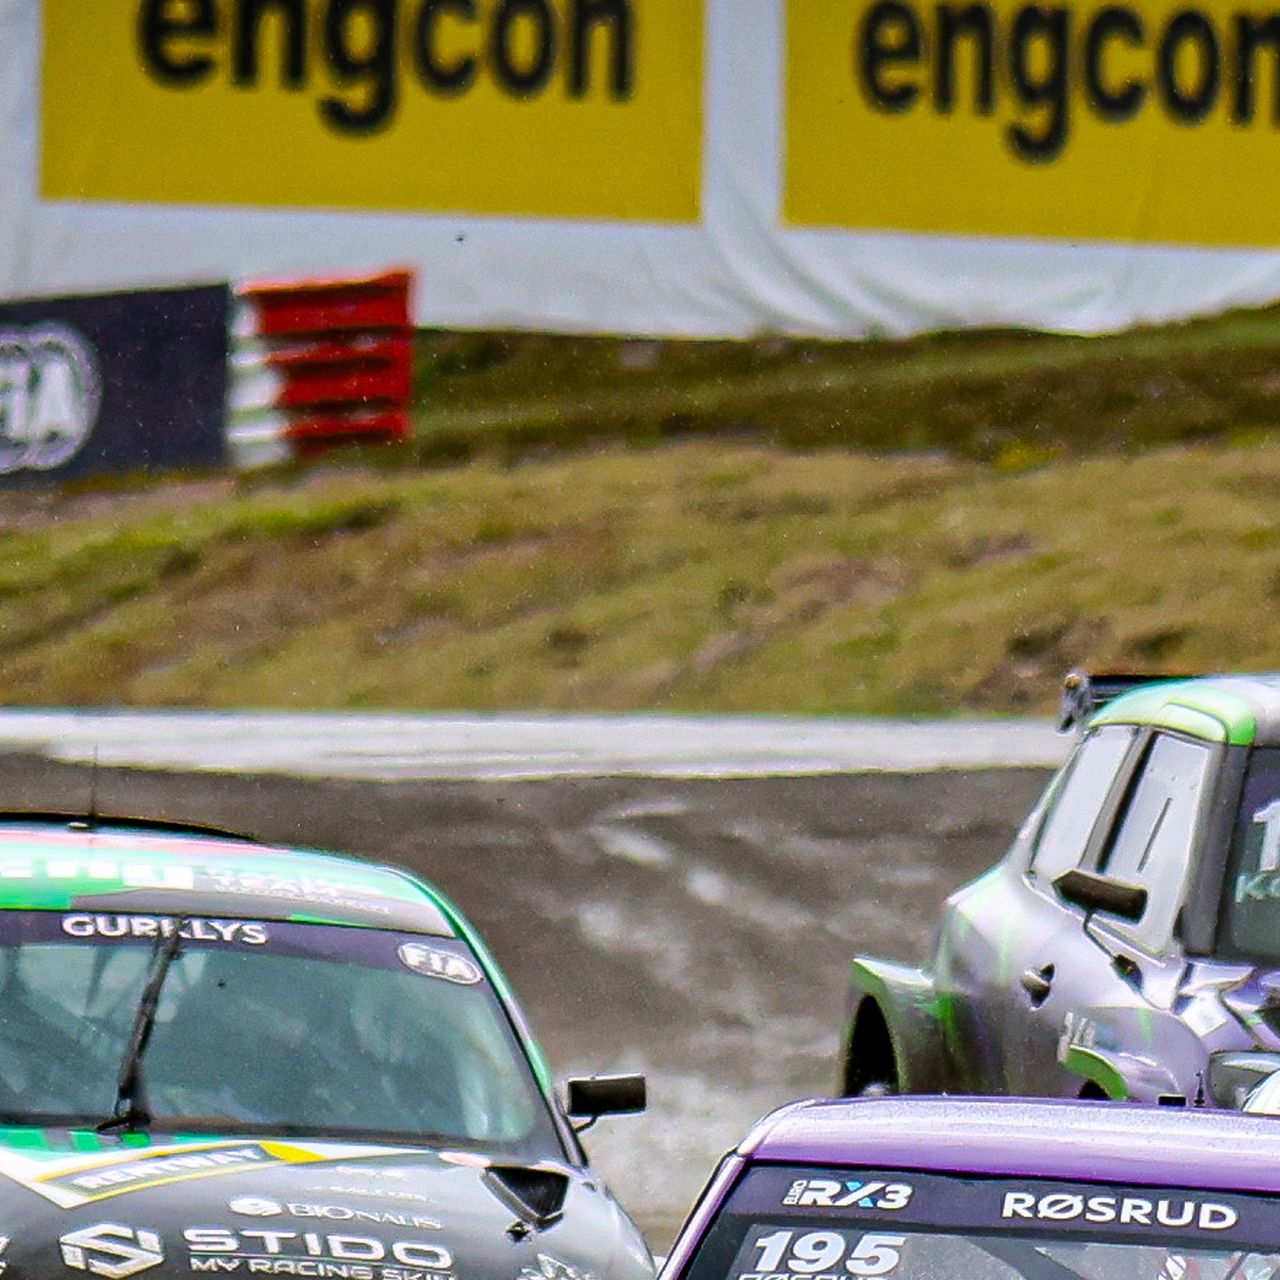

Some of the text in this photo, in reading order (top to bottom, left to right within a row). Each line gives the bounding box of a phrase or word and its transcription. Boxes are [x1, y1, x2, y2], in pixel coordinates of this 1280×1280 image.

[136, 0, 635, 140] engcon
[1001, 1191, 1239, 1230] RØSRUD
[182, 1228, 453, 1269] STIDO
[190, 1257, 244, 1273] MY
[755, 1231, 907, 1276] 195
